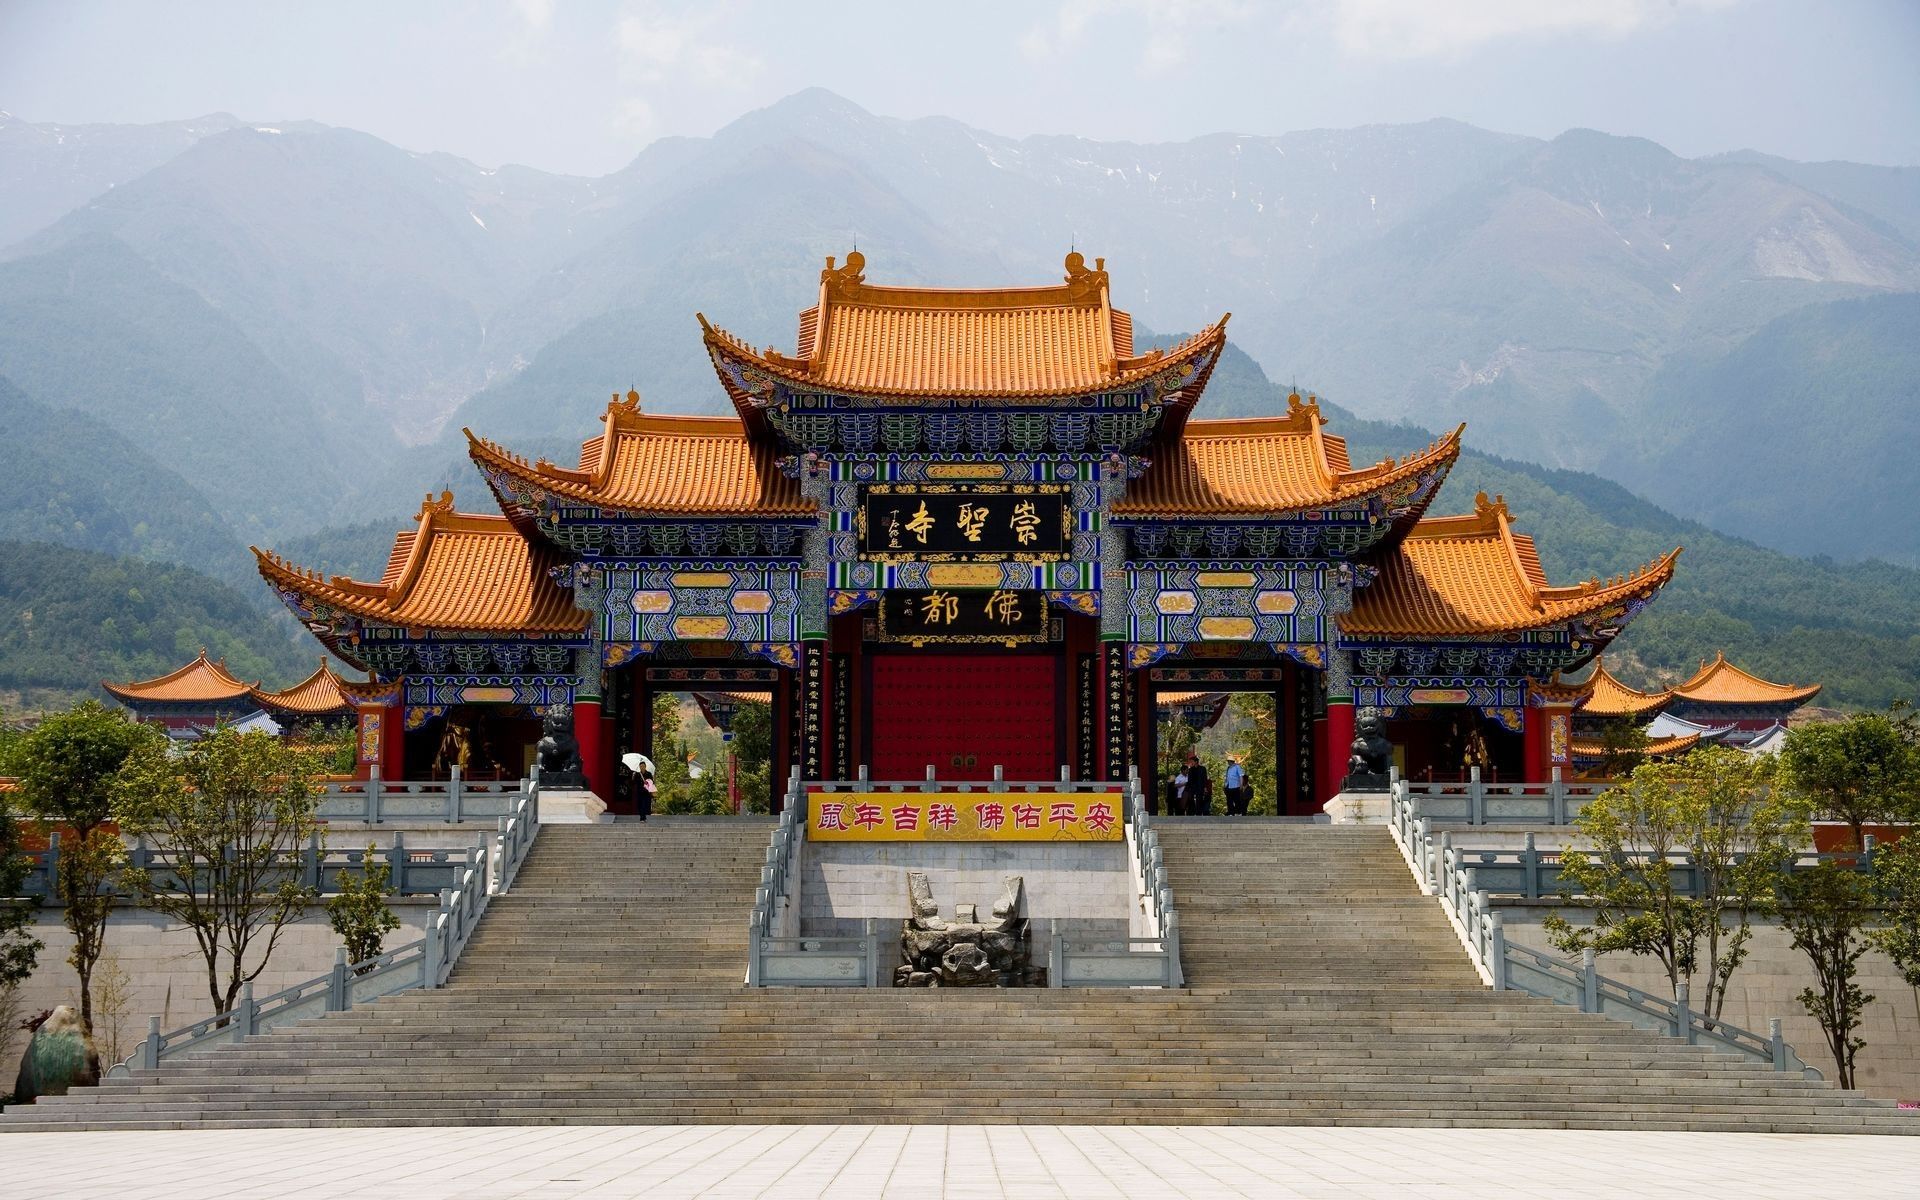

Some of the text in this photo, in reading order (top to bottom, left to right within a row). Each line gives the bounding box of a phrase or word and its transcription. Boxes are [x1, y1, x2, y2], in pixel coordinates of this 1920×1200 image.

[904, 499, 1042, 546] 崇聖寺
[920, 590, 1023, 626] 佛都
[817, 802, 1117, 832] 鼠年吉祥 佛佑平安
